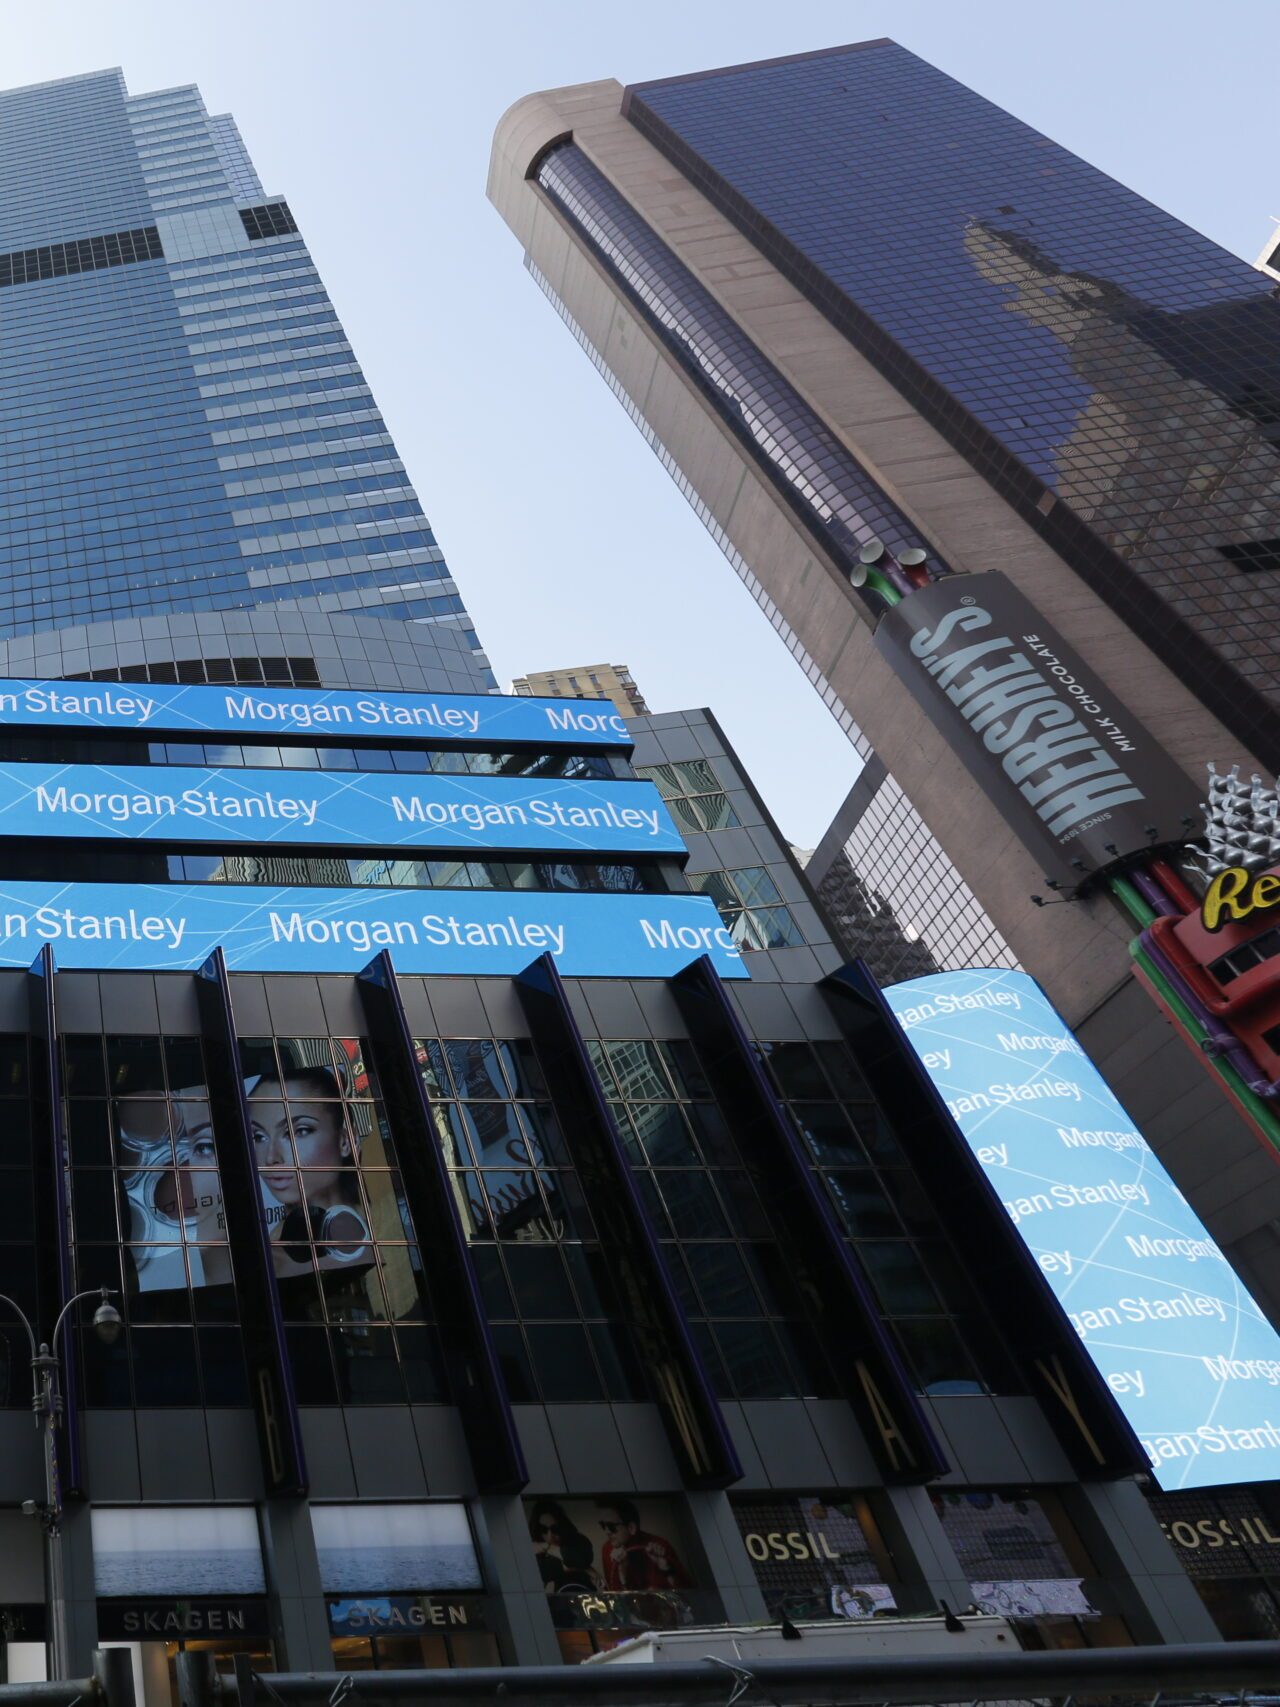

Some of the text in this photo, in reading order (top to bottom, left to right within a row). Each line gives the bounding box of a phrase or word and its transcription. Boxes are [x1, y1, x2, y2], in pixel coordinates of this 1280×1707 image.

[1023, 634, 1136, 752] MILK CHOCOLATE
[25, 689, 154, 721] Stanley
[225, 696, 353, 728] Morgan
[360, 701, 480, 733] Stanley
[910, 606, 1146, 836] HERSHEY'S
[36, 786, 176, 821] Morgan
[181, 790, 319, 826] Stanley
[391, 795, 524, 831] Morgan
[529, 799, 660, 835] Stanley
[34, 907, 186, 949] Stanley
[268, 911, 419, 952] Morgan
[425, 914, 565, 955] Stanley
[934, 988, 1021, 1014] Stanley
[997, 1032, 1073, 1054] Morgan
[922, 1048, 952, 1070] ey
[988, 1077, 1082, 1105] Stanley
[1056, 1127, 1138, 1151] Morgan
[976, 1143, 1009, 1166] ey
[1050, 1179, 1151, 1207] Stanley
[1124, 1234, 1211, 1262] Morgan
[1038, 1250, 1072, 1275] ey
[1118, 1292, 1226, 1322] Stanley
[1107, 1370, 1145, 1398] ey
[745, 1532, 839, 1561] OSSIL
[1160, 1517, 1280, 1549] OSSIL
[123, 1609, 246, 1632] SKAGEN
[347, 1605, 469, 1628] SKAGEN
